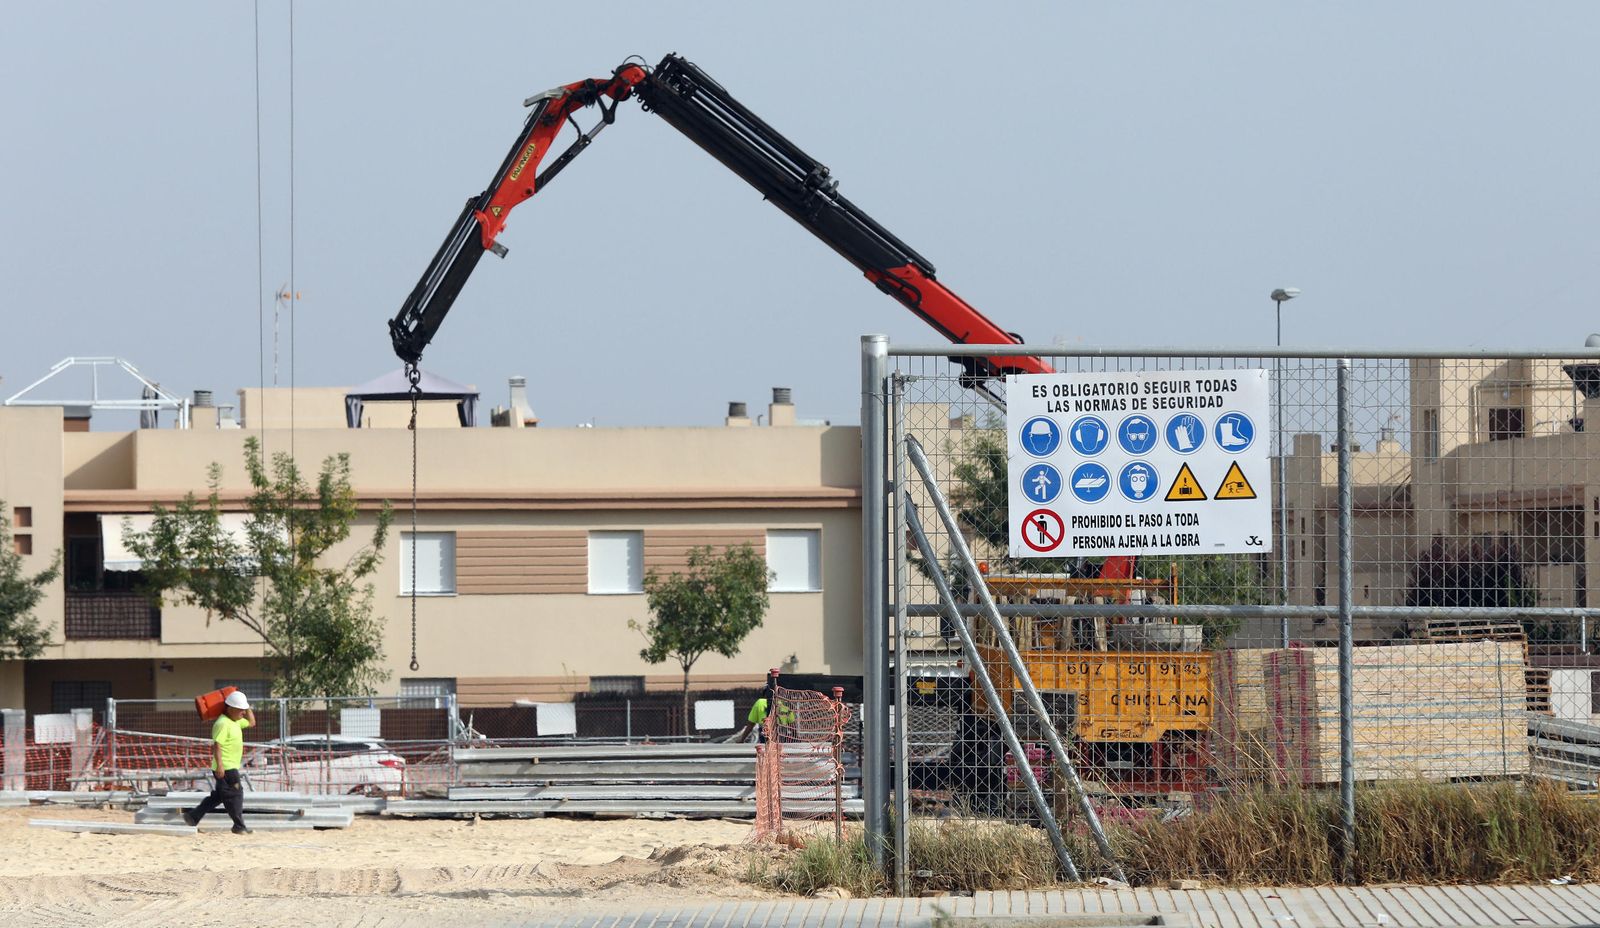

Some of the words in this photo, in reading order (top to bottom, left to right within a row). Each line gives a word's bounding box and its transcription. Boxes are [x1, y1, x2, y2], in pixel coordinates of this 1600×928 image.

[1033, 385, 1047, 397] ES
[1053, 382, 1138, 397] OBLIGATORIO
[1144, 381, 1190, 394] SEGUIR
[1196, 379, 1237, 392] TODAS
[1048, 400, 1069, 412] LAS
[1075, 399, 1126, 411] NORMAS
[1132, 398, 1147, 410] DE
[1153, 396, 1223, 409] SEGURIDAD
[1072, 515, 1122, 528] PROHIBIDO
[1126, 515, 1136, 527] EL
[1139, 514, 1162, 527] PASO
[1165, 514, 1173, 526] A
[1175, 513, 1199, 526] TODA
[1073, 536, 1115, 549] PERSONA
[1119, 535, 1148, 548] AJENA
[1151, 535, 1159, 547] A
[1161, 534, 1172, 547] LA
[1175, 534, 1200, 547] OBRA
[1129, 663, 1146, 675] 50
